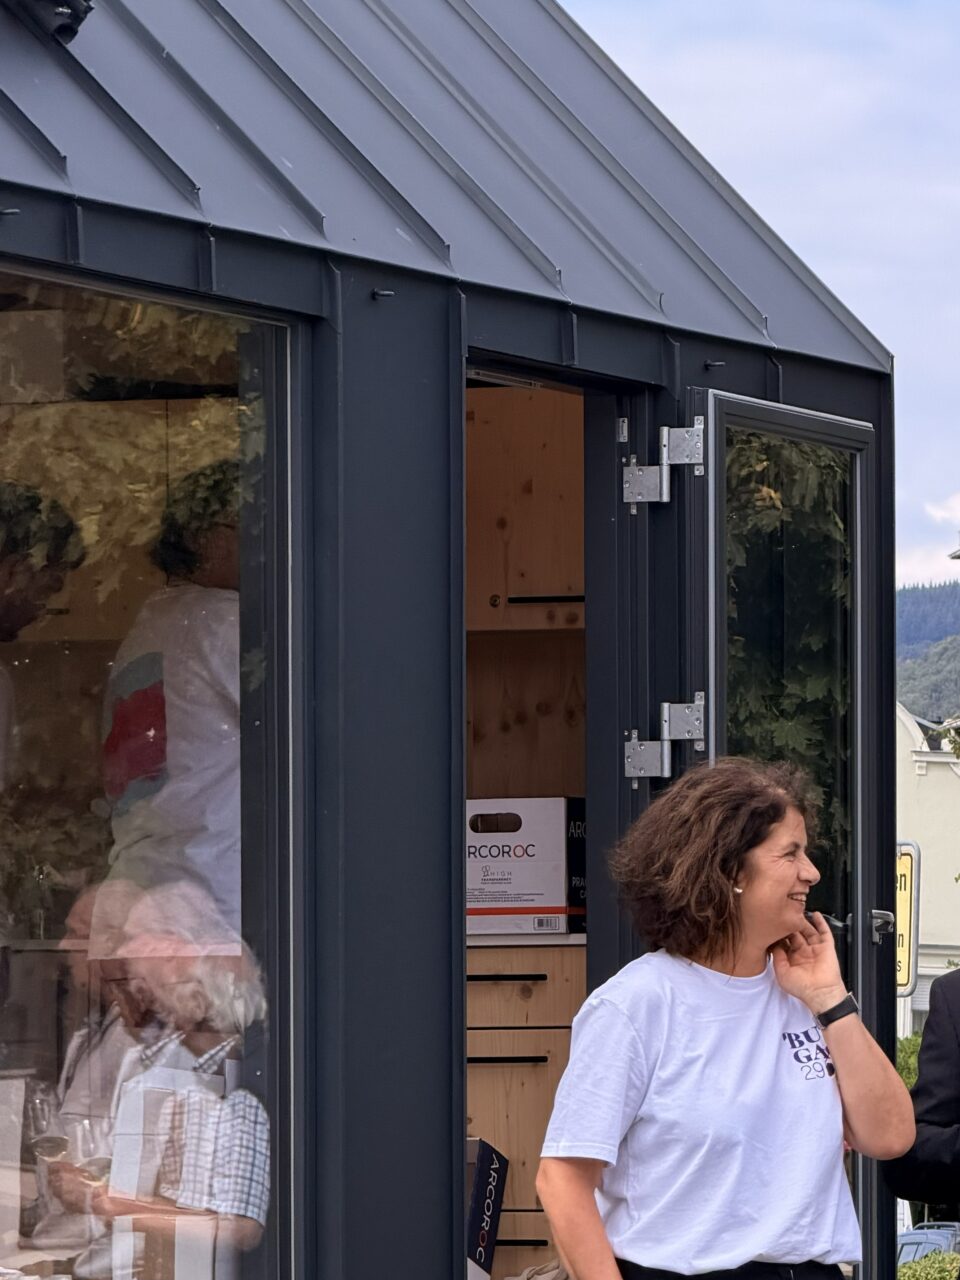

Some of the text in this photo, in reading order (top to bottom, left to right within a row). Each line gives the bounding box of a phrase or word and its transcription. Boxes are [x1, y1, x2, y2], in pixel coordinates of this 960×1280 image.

[467, 844, 536, 859] RCOROC
[800, 1061, 826, 1081] 29
[476, 1153, 500, 1263] ARCOROC
